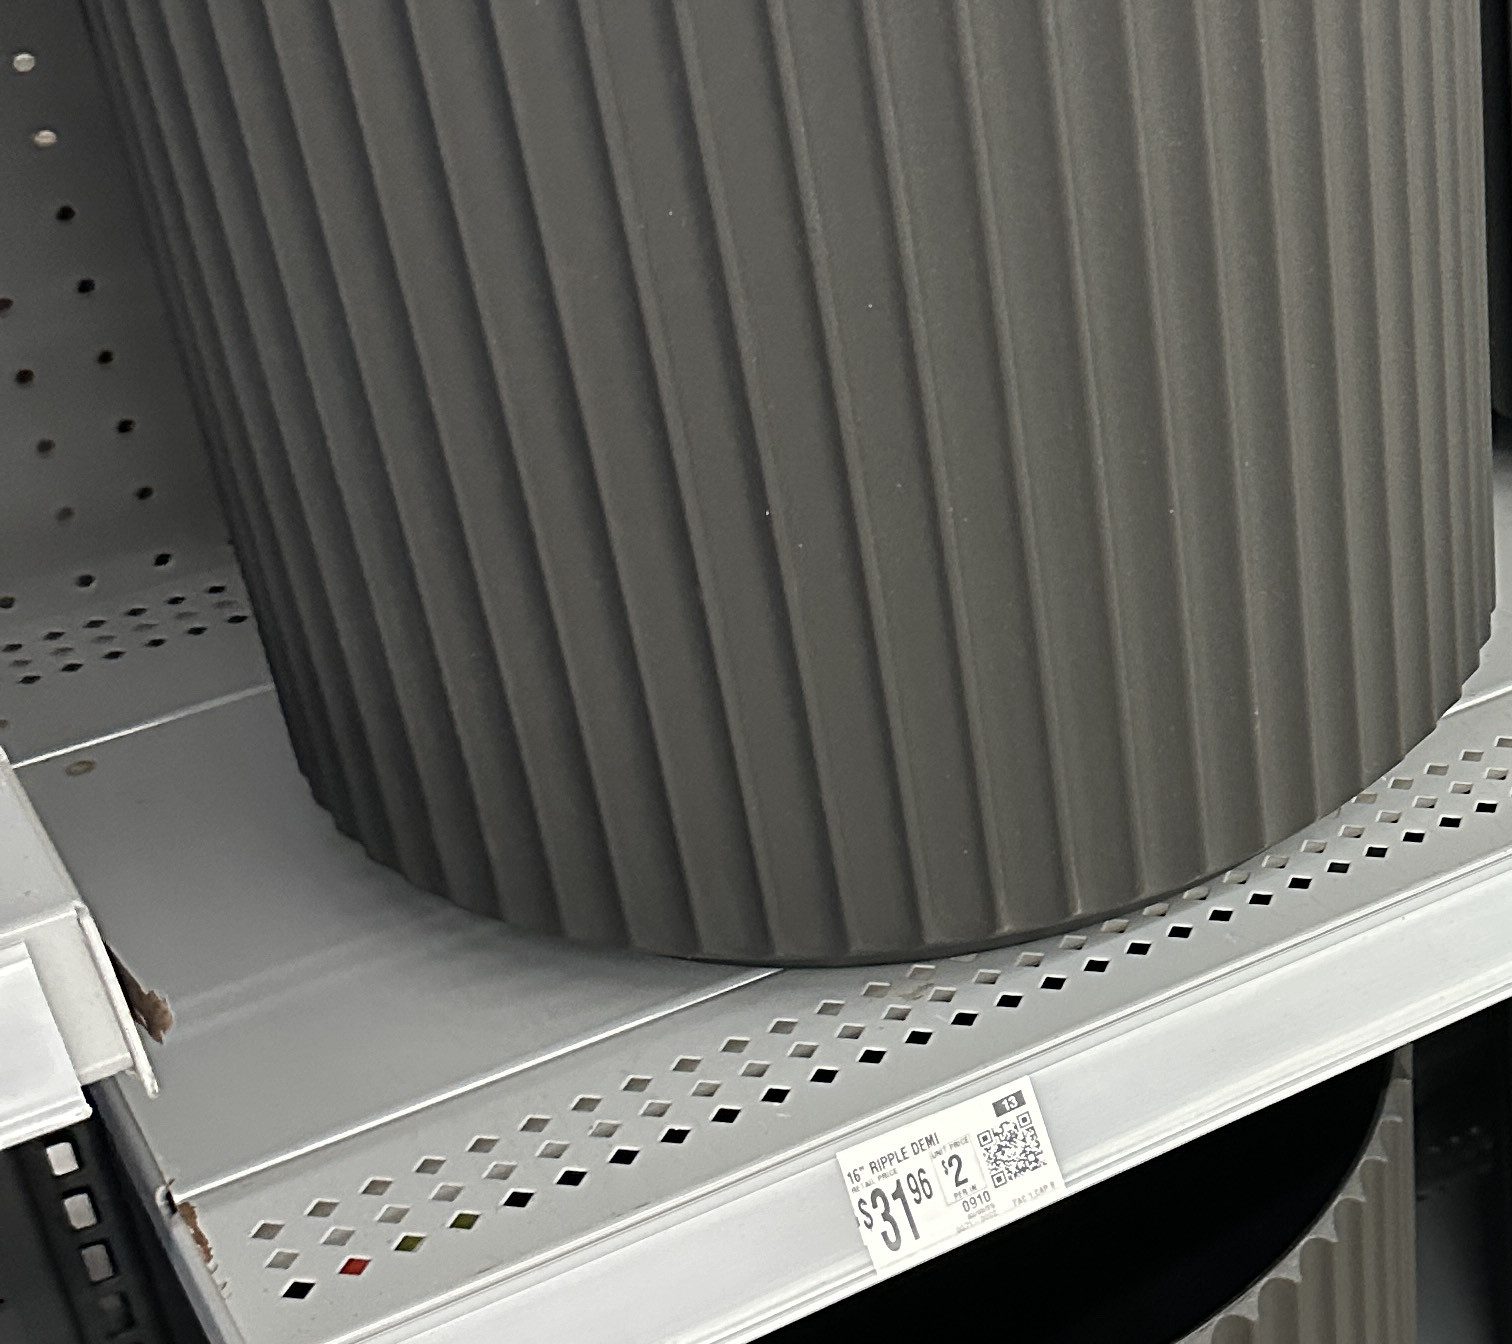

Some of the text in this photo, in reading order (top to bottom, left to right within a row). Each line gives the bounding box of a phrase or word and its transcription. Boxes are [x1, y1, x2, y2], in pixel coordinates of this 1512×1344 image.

[1001, 1095, 1019, 1112] 13
[868, 1146, 909, 1174] RIPPLE
[910, 1132, 940, 1156] DEMI
[941, 1153, 969, 1187] $2
[962, 1190, 991, 1212] 0910
